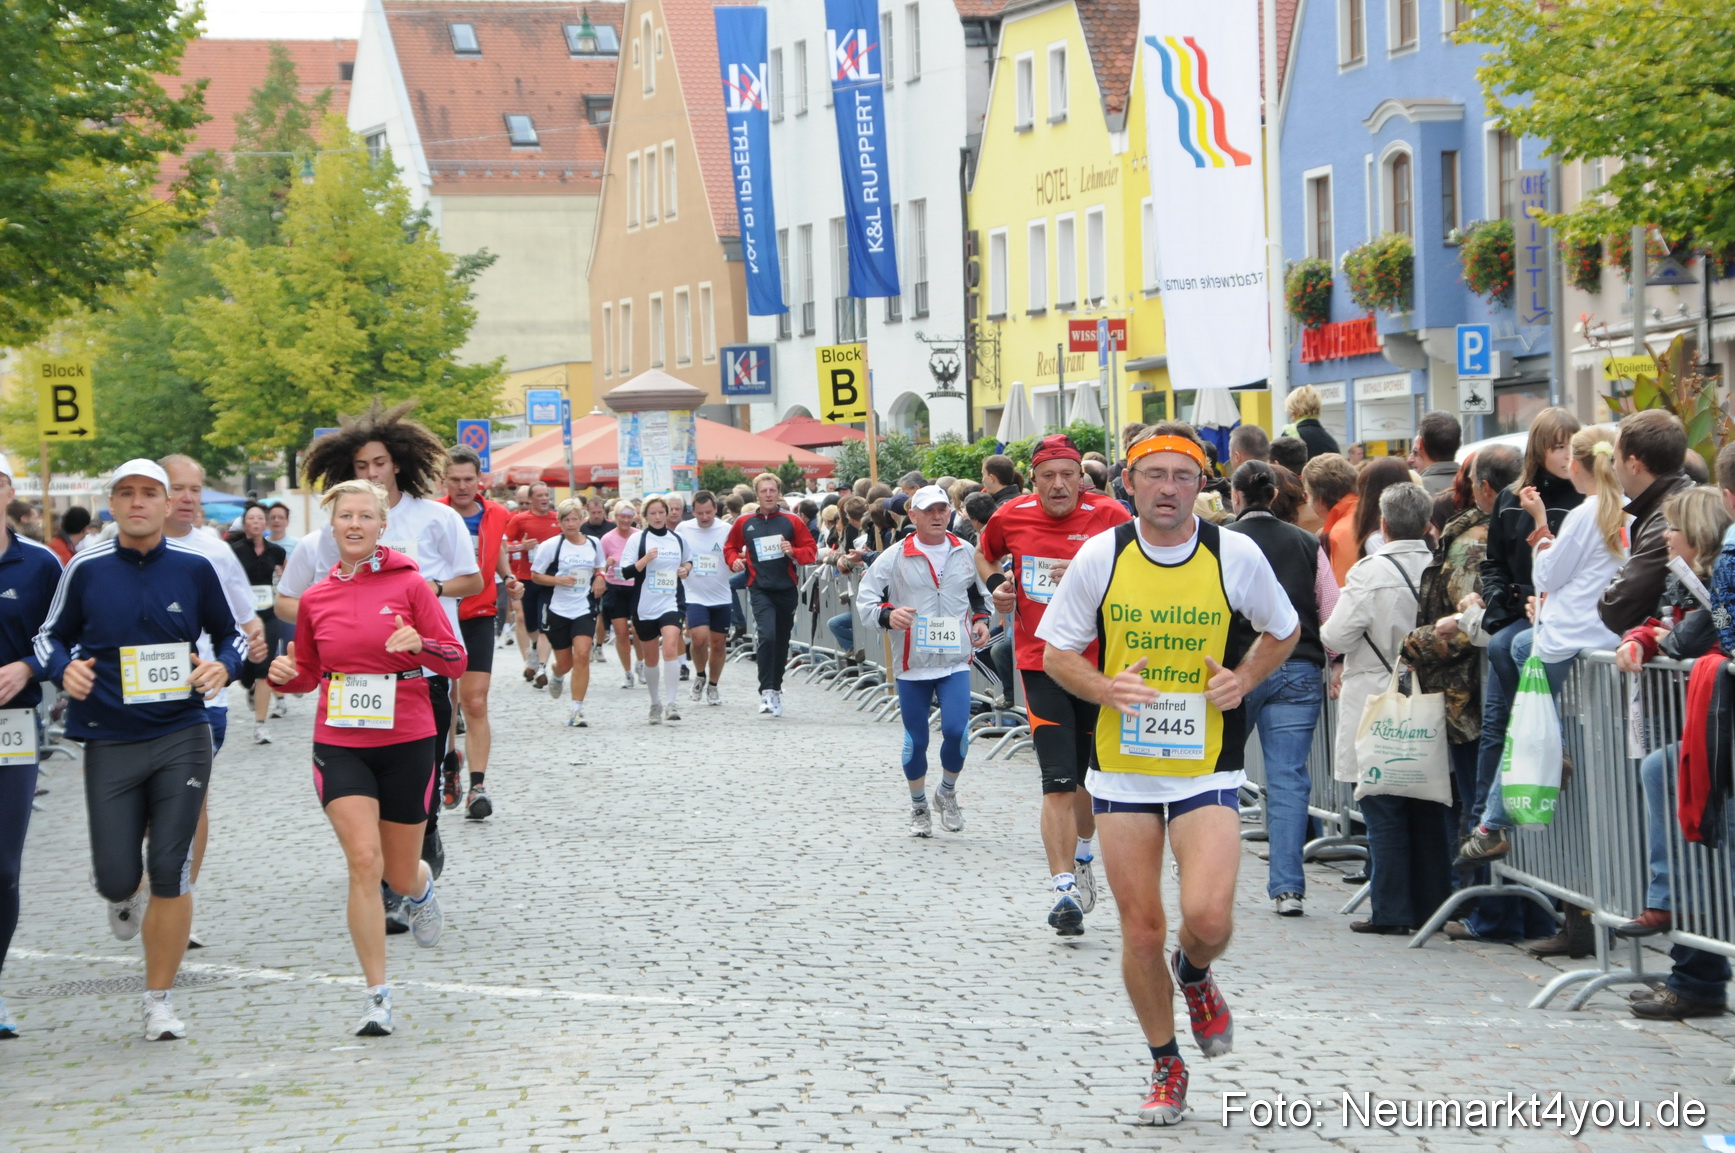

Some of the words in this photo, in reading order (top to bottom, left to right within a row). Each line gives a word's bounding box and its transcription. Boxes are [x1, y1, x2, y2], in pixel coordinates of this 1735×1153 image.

[826, 29, 880, 81] K&L
[855, 90, 879, 203] RUPPERT
[1036, 168, 1071, 206] HOTEL
[1080, 160, 1119, 193] Lehmeier
[1071, 329, 1125, 342] WISSACH
[822, 347, 862, 363] Block
[1463, 331, 1484, 369] P
[42, 363, 85, 378] Block
[1037, 351, 1085, 377] Resturant
[831, 369, 859, 407] B
[52, 384, 80, 423] B
[1110, 603, 1142, 622] Die
[1150, 605, 1222, 626] wilden
[929, 631, 956, 641] 3143
[1125, 631, 1207, 652] Gärtner
[140, 650, 176, 662] Andreas
[148, 666, 180, 683] 605
[345, 676, 368, 687] Silvia
[1125, 663, 1201, 684] anfred
[350, 694, 382, 709] 606
[1144, 699, 1186, 712] Manfred
[1145, 717, 1195, 736] 2445
